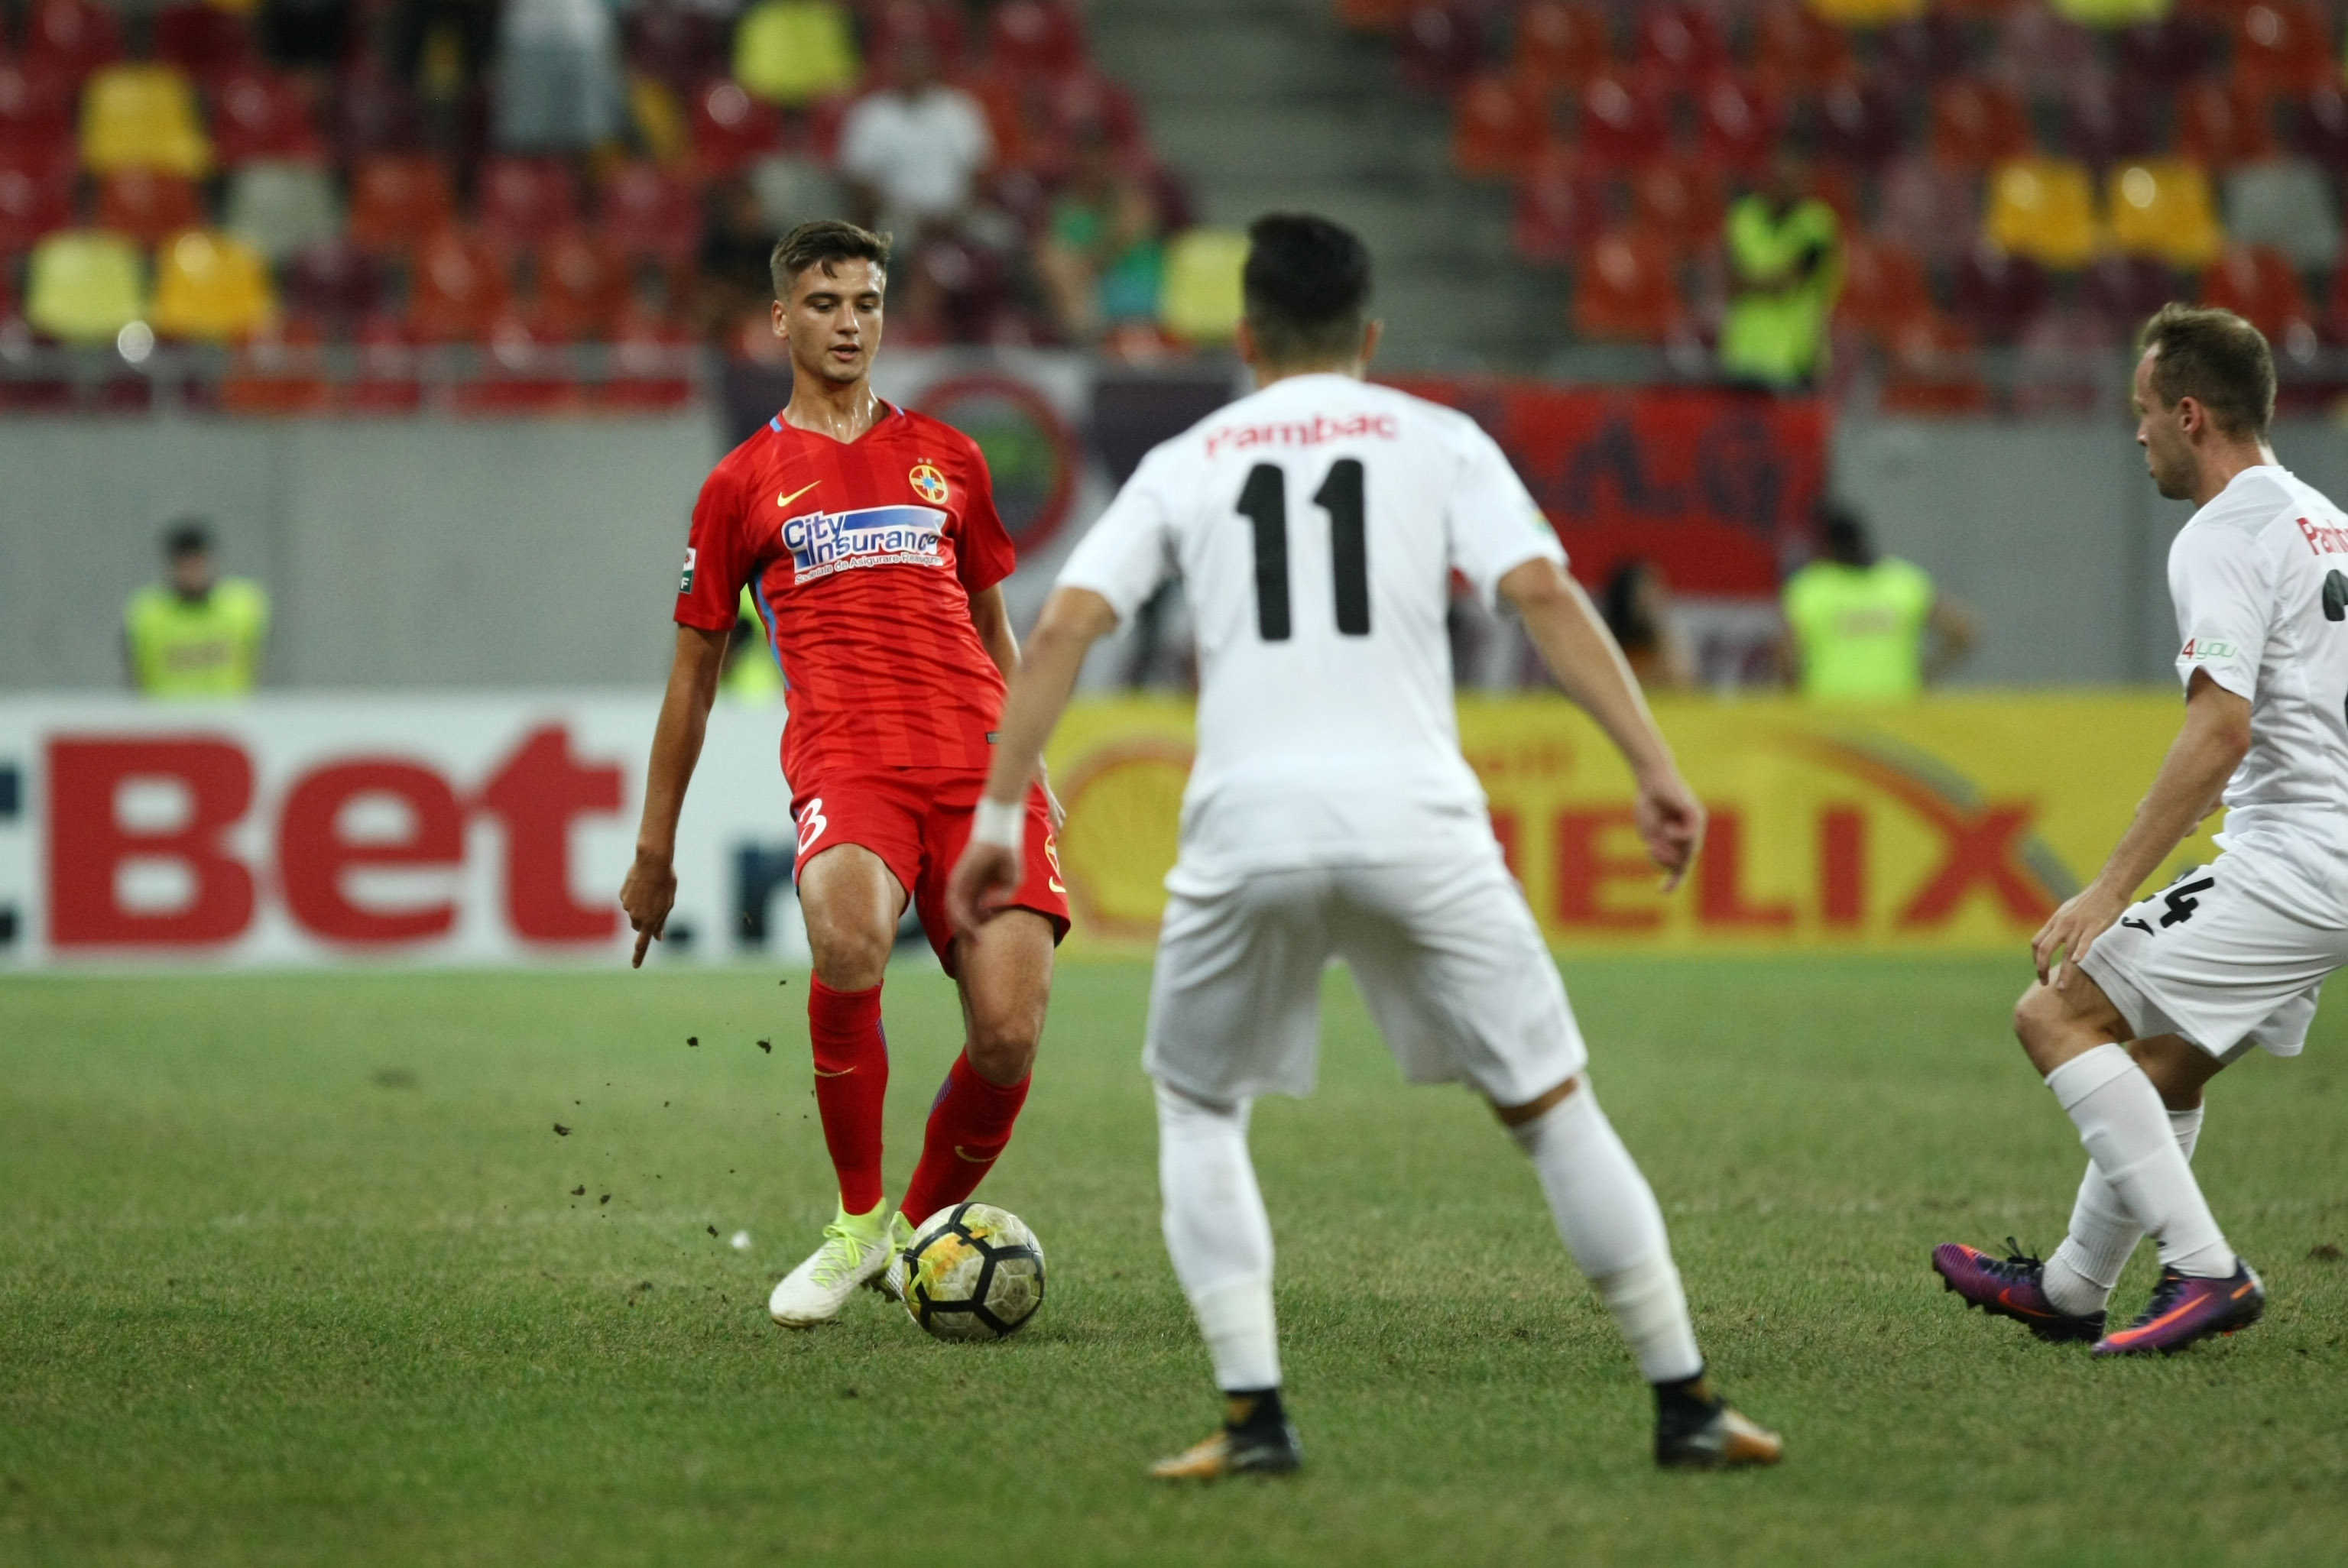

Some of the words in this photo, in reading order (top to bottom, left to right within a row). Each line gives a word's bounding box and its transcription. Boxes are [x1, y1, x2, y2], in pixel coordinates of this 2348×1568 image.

[784, 515, 844, 549] City
[1235, 458, 1370, 640] 11
[836, 561, 849, 571] de
[2181, 637, 2239, 659] 4you
[798, 798, 827, 856] 3
[1487, 807, 2060, 928] ELIX
[2142, 867, 2214, 928] 4
